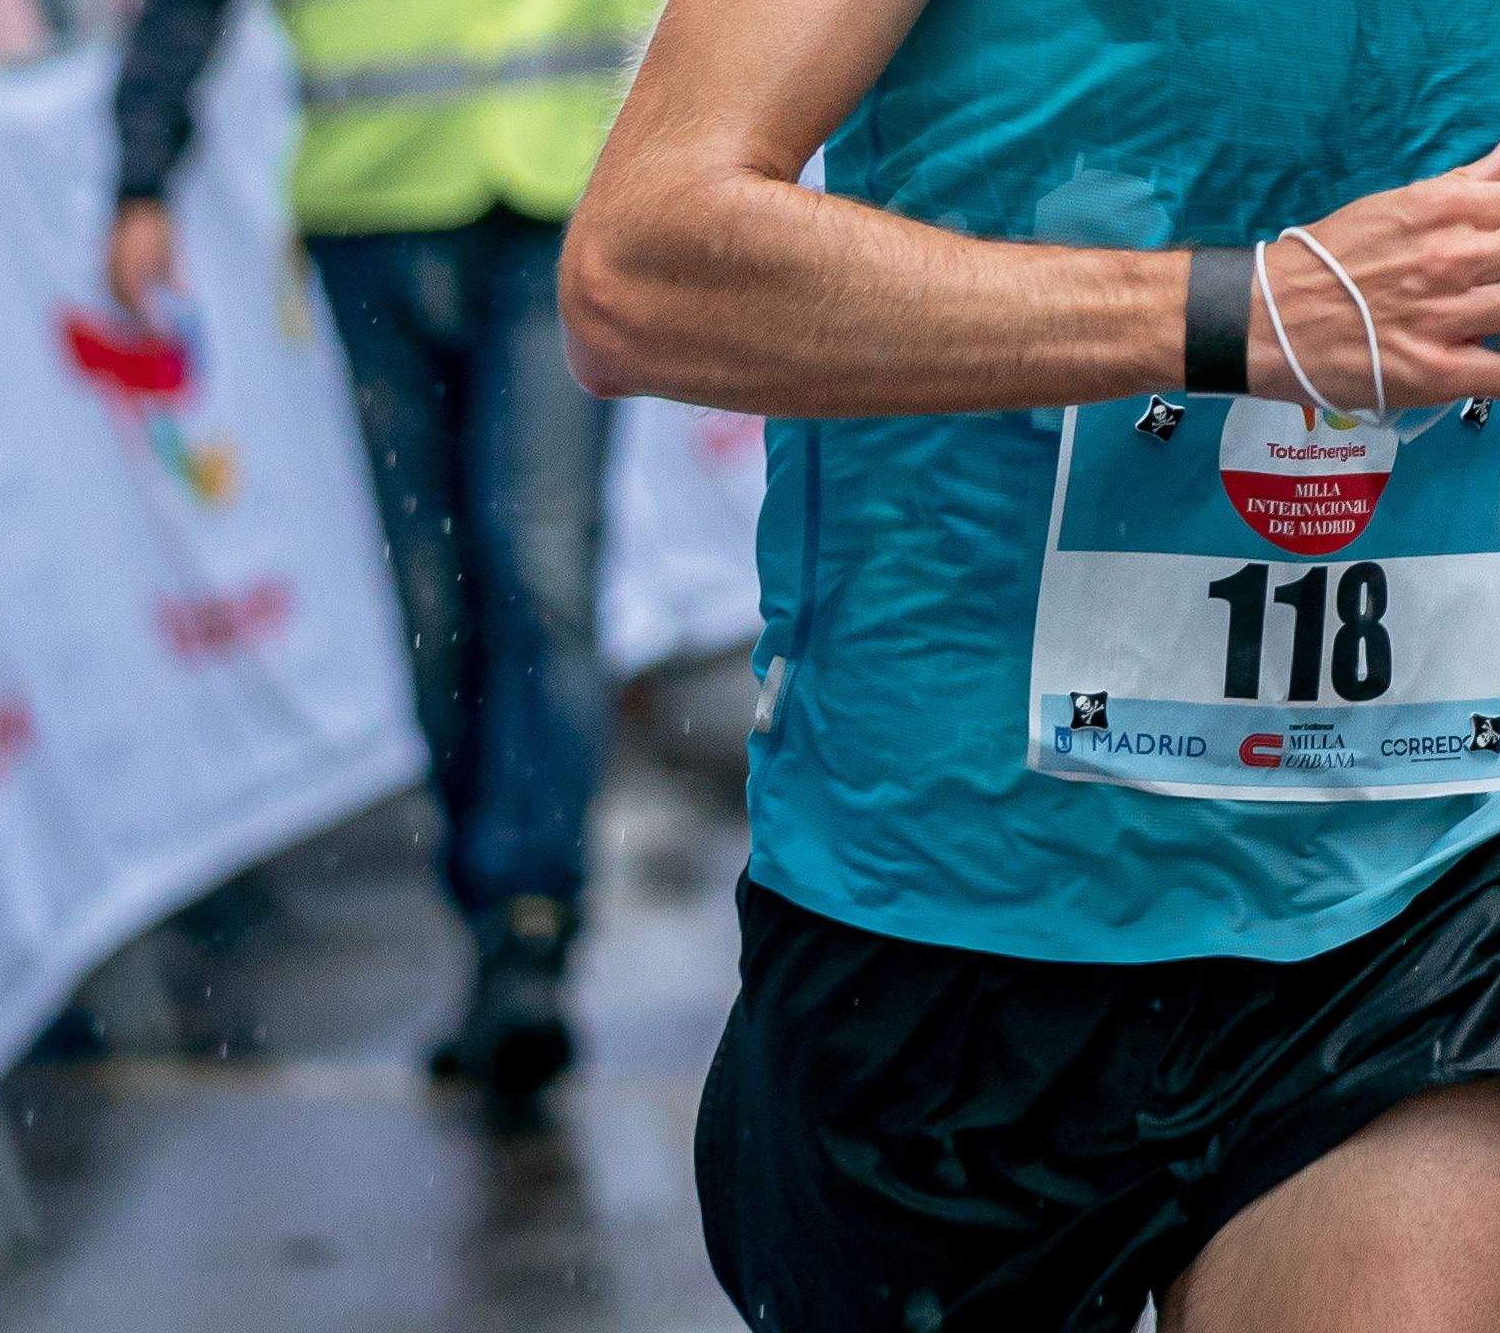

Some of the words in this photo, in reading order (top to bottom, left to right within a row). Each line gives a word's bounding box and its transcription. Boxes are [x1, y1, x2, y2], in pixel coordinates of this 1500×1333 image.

[1266, 442, 1366, 462] TotalEnergies
[1295, 482, 1341, 498] MILLA
[1246, 498, 1370, 517] INTERNACIONAL
[1268, 519, 1295, 536] DE
[1300, 519, 1356, 535] MADRID
[1208, 561, 1392, 702] 118
[1092, 732, 1207, 758] MADRID
[1290, 734, 1345, 749] MILLA
[1381, 735, 1472, 757] CORREDO
[1285, 753, 1357, 769] URBANA
